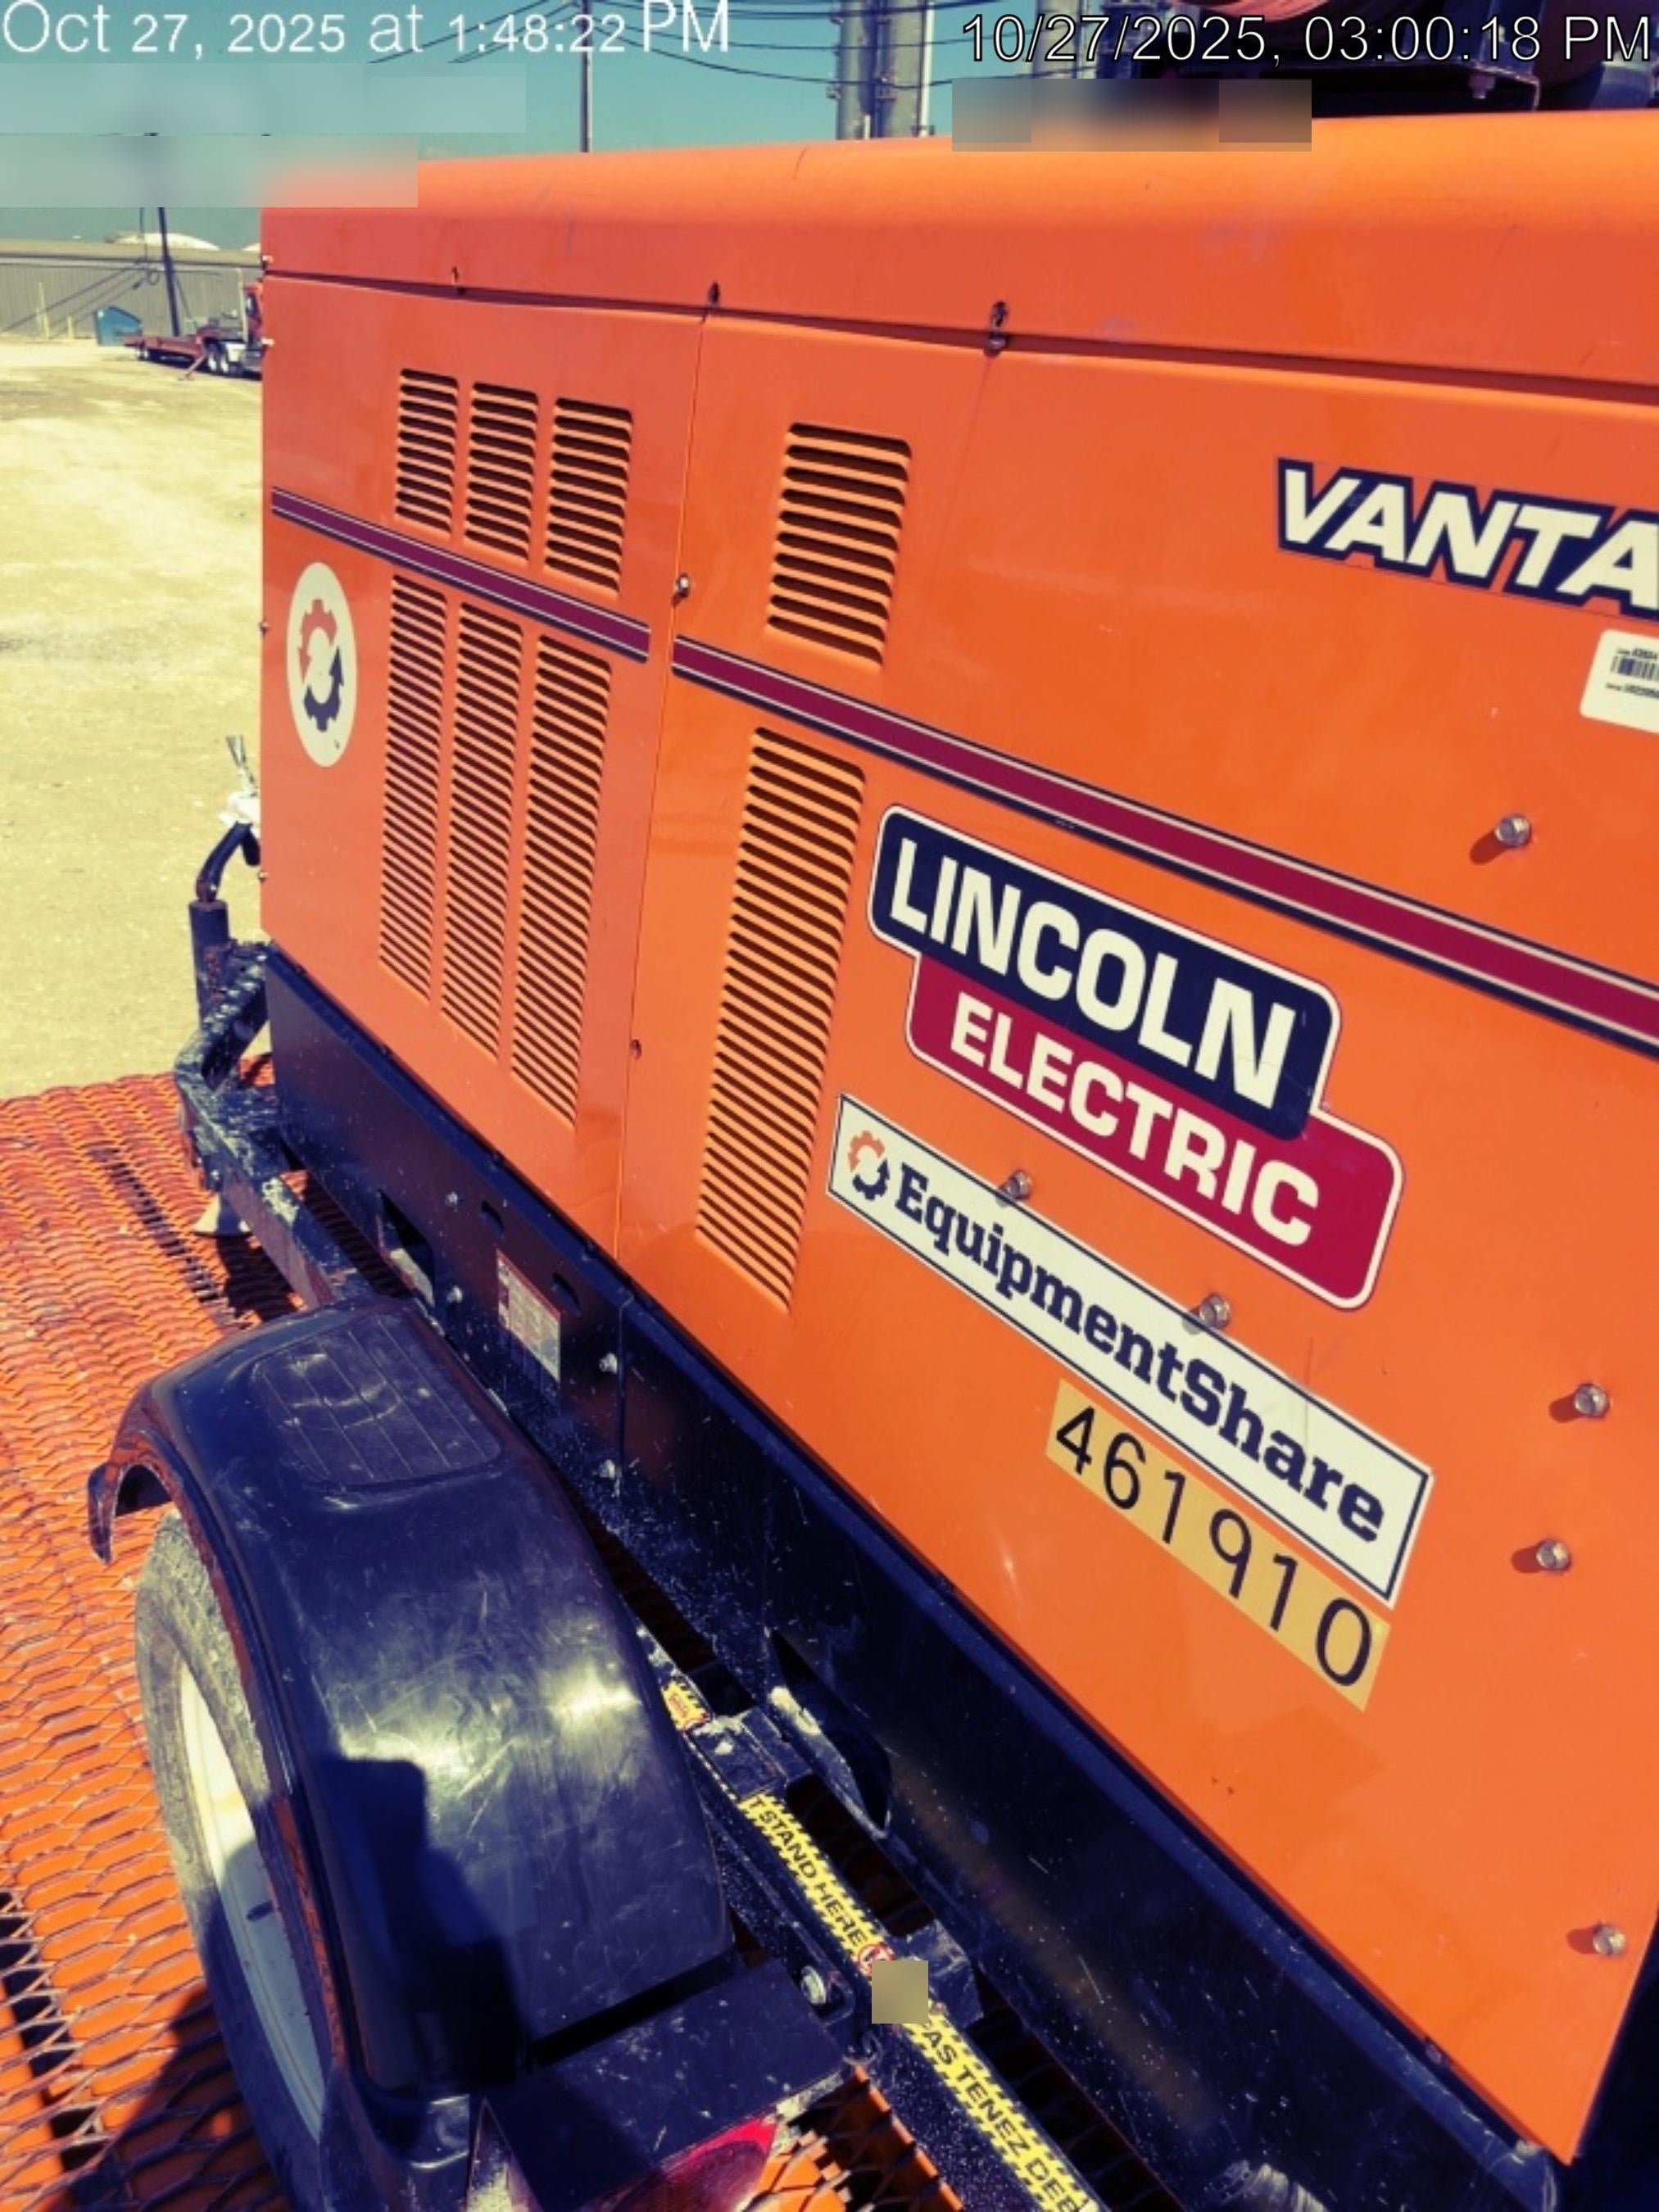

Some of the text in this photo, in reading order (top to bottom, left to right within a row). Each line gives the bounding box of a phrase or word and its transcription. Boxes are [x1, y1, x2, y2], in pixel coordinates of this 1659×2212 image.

[1284, 469, 1659, 610] VANTA
[890, 837, 1297, 1110] LINCOLN
[950, 991, 1320, 1246] ELECTRIC
[894, 1163, 1385, 1543] EquipmentShare
[1055, 1407, 1373, 1688] 461910
[759, 1810, 818, 1879] STAND
[812, 1881, 868, 1946] HERE
[956, 2064, 1031, 2158] TENEZ
